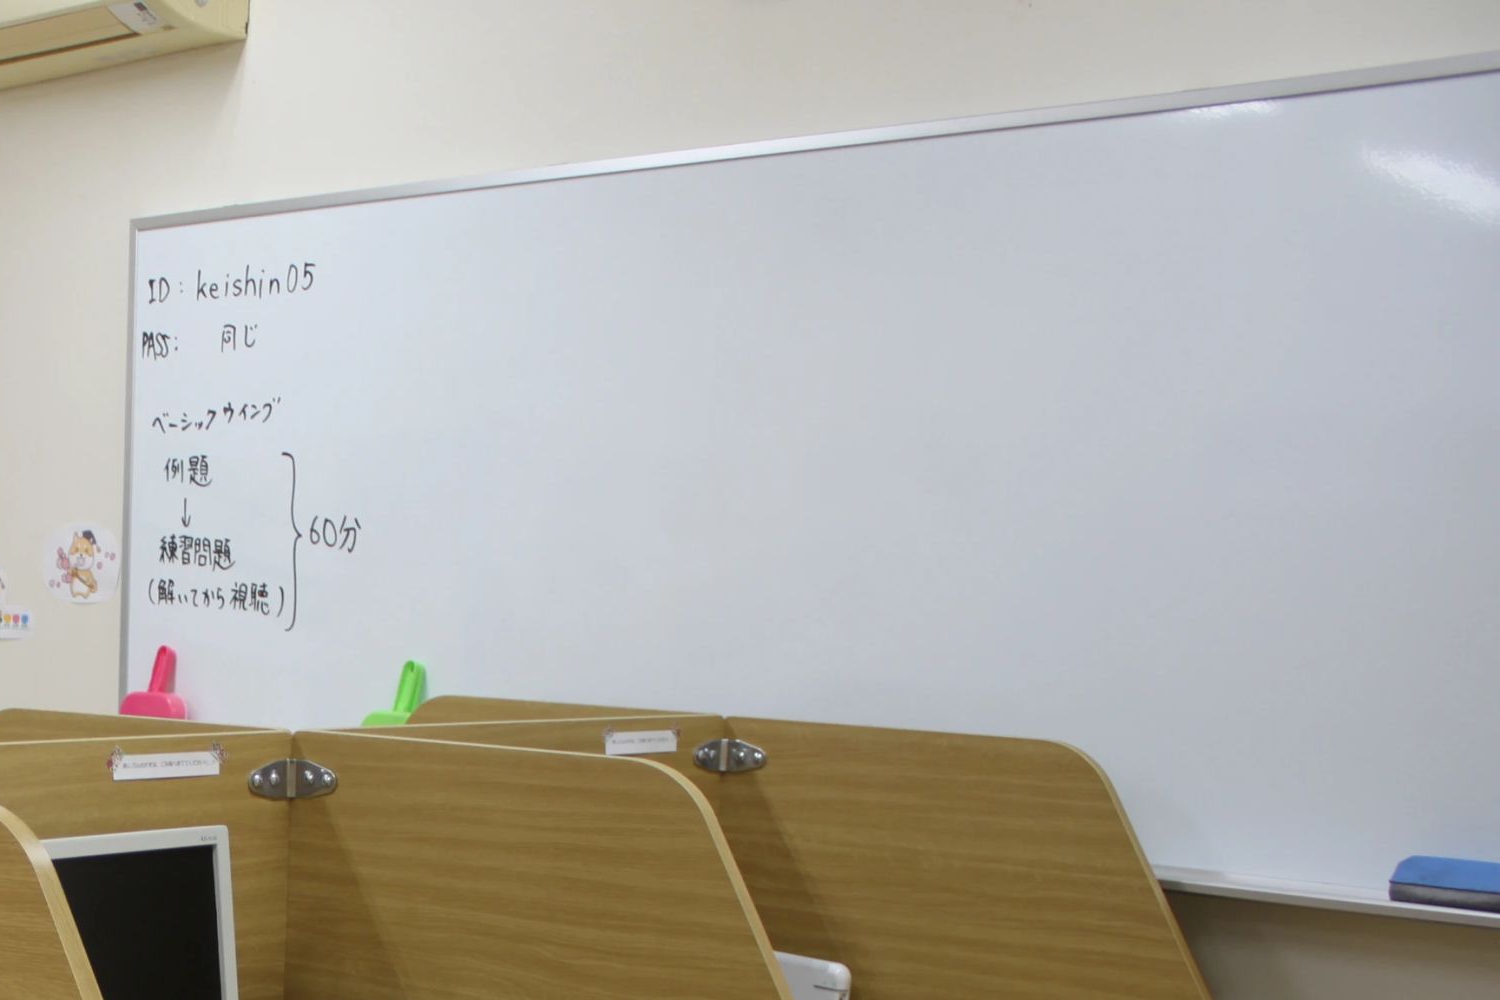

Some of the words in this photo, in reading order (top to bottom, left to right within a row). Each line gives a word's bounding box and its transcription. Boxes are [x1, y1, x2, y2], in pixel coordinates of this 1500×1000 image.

[196, 262, 316, 301] keishin05
[220, 323, 259, 353] 同じ
[163, 454, 213, 488] 例題
[158, 534, 236, 572] 練習問題
[308, 514, 362, 554] 60分
